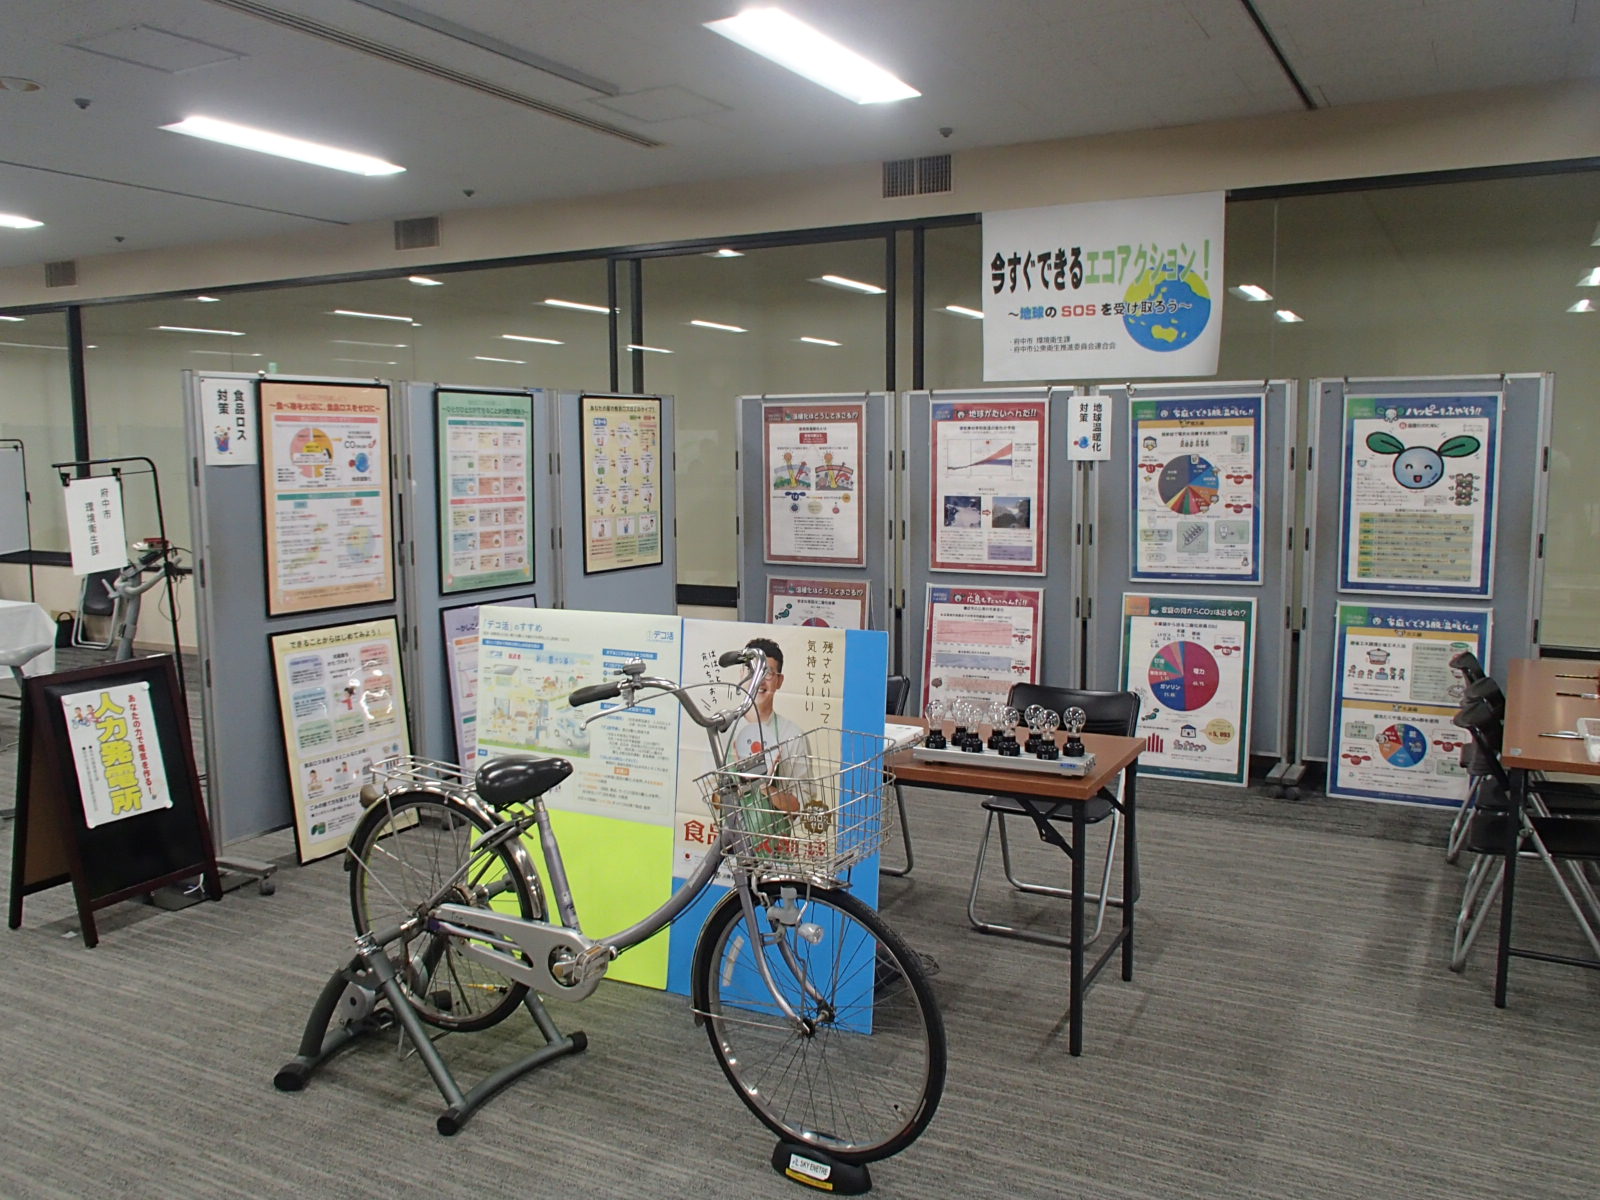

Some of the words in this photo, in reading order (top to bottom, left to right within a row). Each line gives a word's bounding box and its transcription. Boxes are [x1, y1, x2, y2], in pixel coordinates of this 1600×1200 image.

[991, 240, 1210, 294] 今すぐできるエコアクション！
[1061, 303, 1097, 318] SOS
[216, 388, 229, 416] 対策
[234, 388, 247, 441] 食品ロス
[1079, 402, 1089, 423] 対策
[1092, 402, 1103, 452] 地球温暖化
[85, 501, 99, 557] 環境衛生課
[100, 487, 112, 520] 府中市
[805, 638, 818, 713] 気持ちいい
[821, 640, 835, 724] 残さないって
[95, 691, 143, 816] 人力発電所
